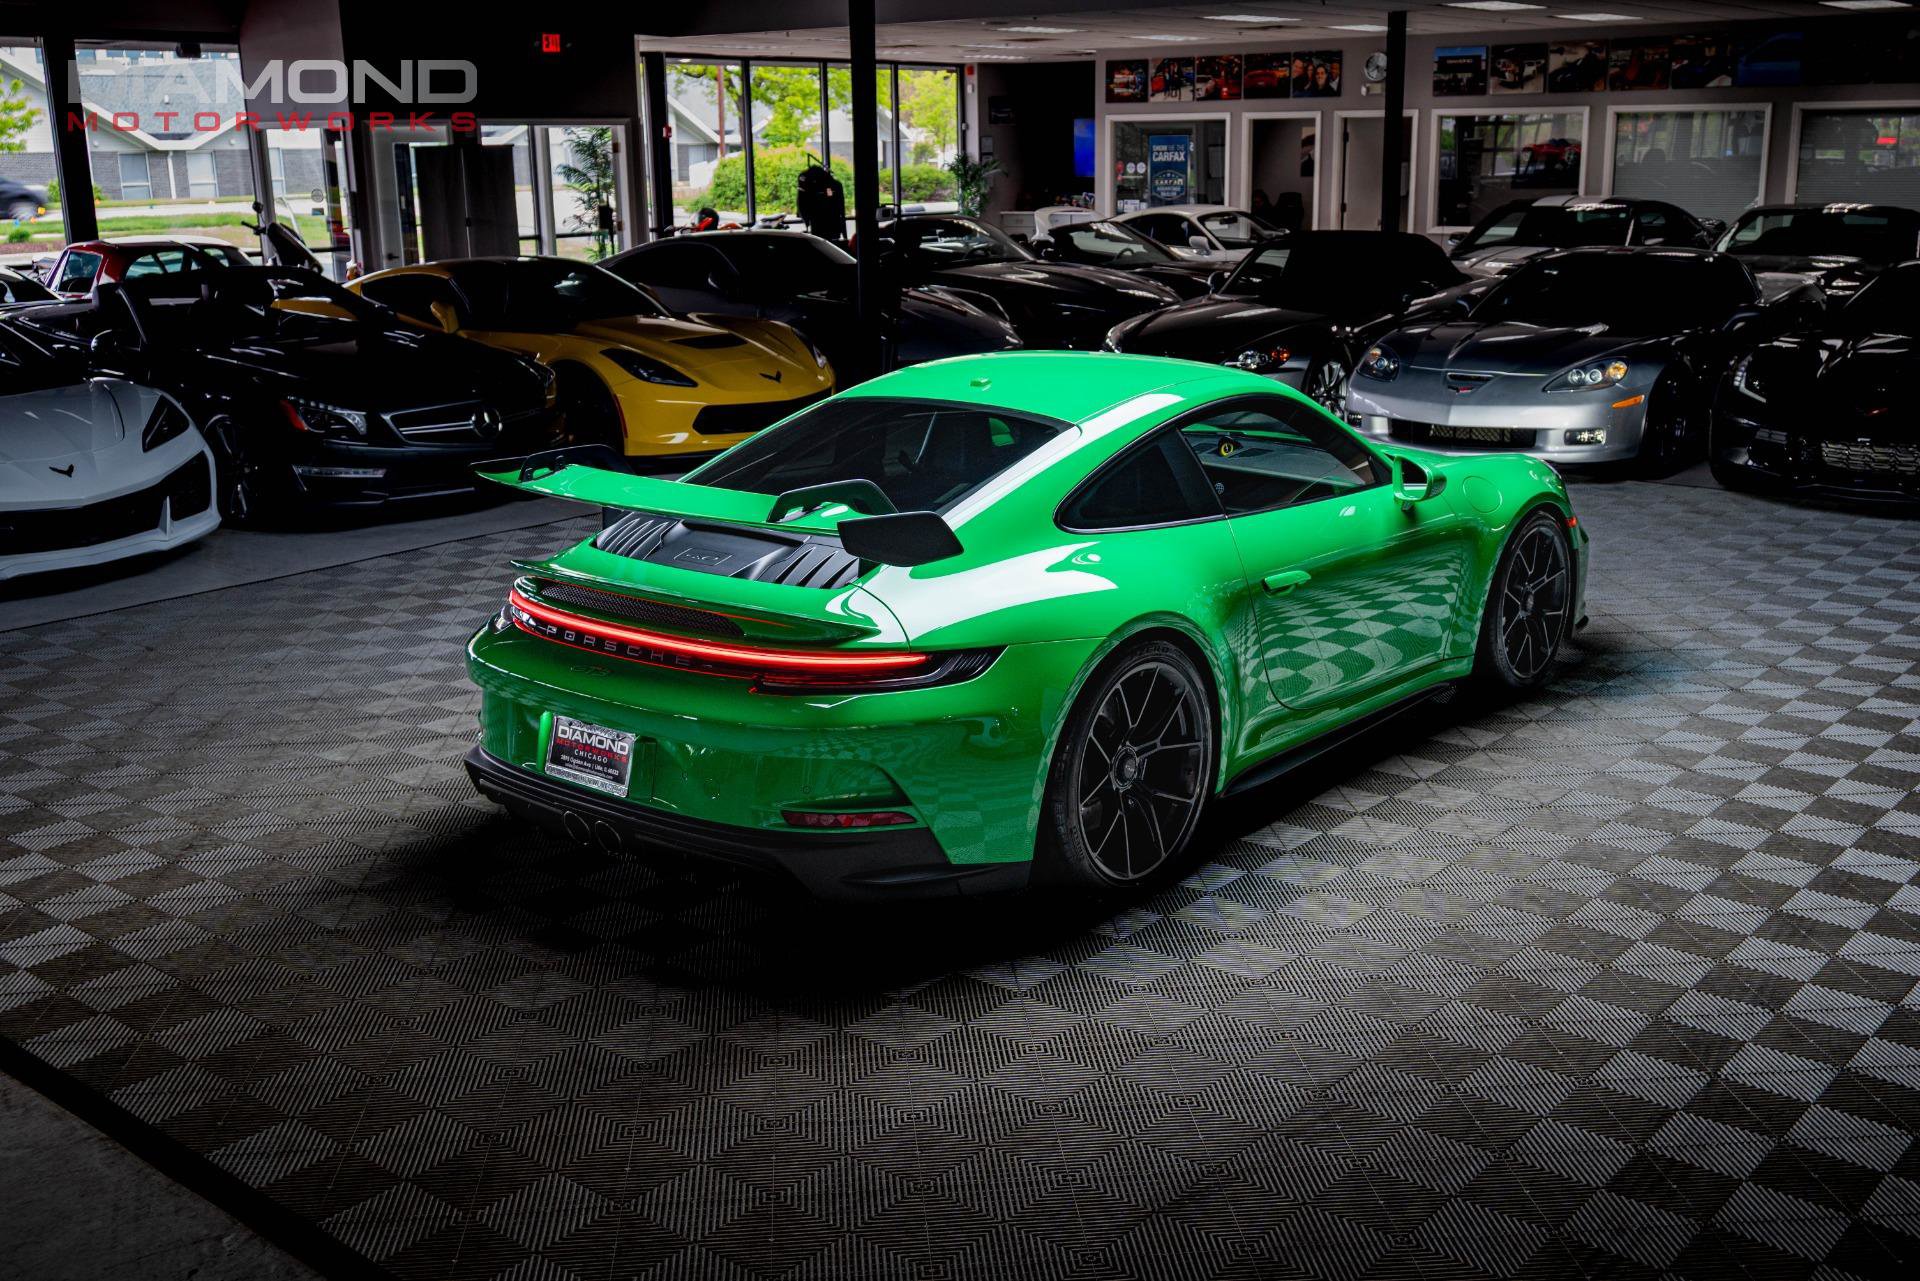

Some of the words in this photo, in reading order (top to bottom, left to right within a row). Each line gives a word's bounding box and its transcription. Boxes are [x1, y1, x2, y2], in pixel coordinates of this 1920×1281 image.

[1152, 151, 1186, 162] CARFAX
[546, 625, 693, 667] PORSCHE
[557, 725, 629, 755] DIAMOND
[574, 748, 608, 764] CHICAGO
